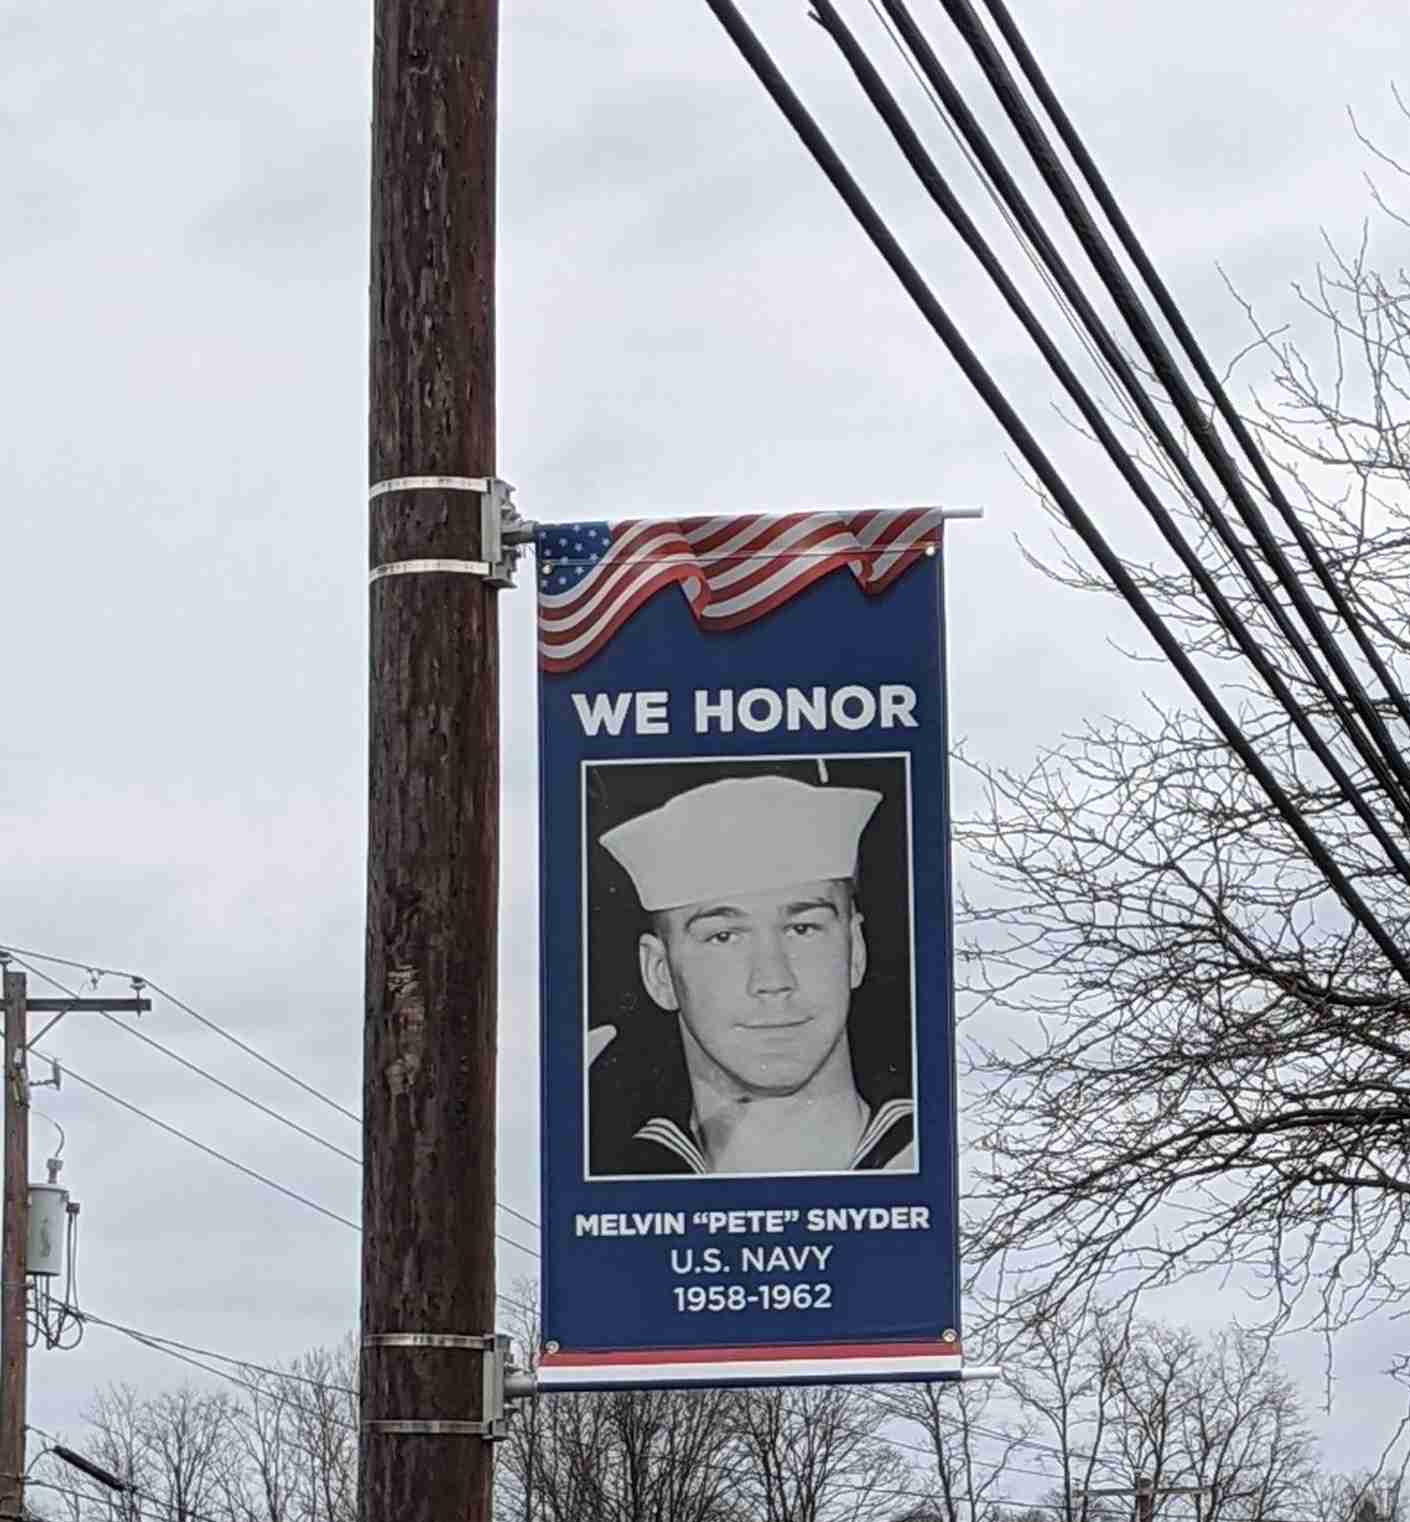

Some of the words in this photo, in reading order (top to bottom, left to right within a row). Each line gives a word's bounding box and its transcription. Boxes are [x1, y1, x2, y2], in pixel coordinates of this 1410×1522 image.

[572, 690, 669, 736] WE
[693, 684, 919, 735] HONOR
[575, 1212, 685, 1236] MELVIN
[693, 1210, 799, 1233] “PETE”
[807, 1206, 931, 1231] SNYDER
[671, 1248, 730, 1274] U.S.
[742, 1246, 834, 1272] NAVY
[673, 1284, 832, 1311] 1958-1962
